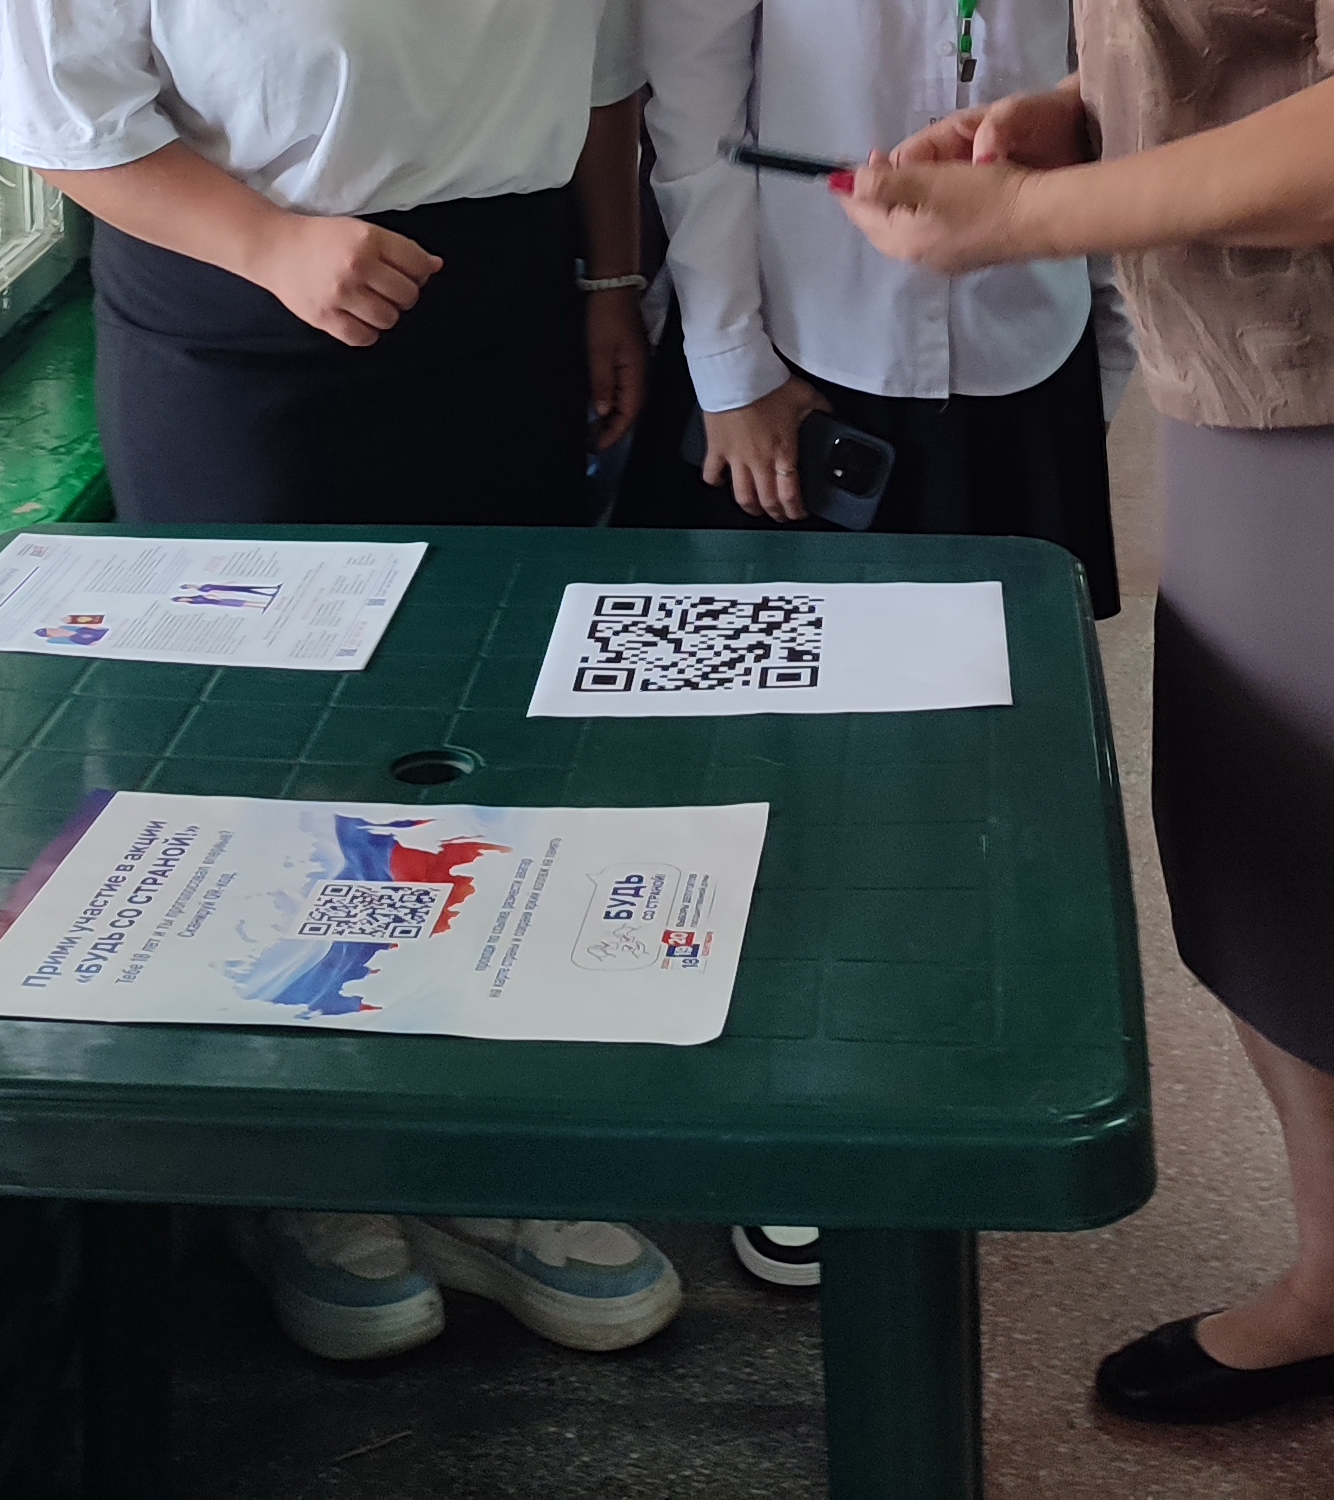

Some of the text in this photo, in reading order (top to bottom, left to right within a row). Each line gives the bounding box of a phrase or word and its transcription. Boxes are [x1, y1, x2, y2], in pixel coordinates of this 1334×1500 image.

[21, 936, 81, 987] Прими
[68, 875, 126, 932] участие
[123, 820, 166, 860] акции
[74, 825, 199, 982] «БУДЬ СО СТРАНОЙ!»
[176, 901, 216, 937] Сканируй
[603, 874, 646, 919] БУДЬ
[642, 910, 655, 920] СО
[114, 964, 143, 983] Тебе
[130, 953, 150, 961] 18
[141, 937, 160, 952] лет
[156, 918, 173, 929] ты
[165, 866, 210, 917] проголосовал
[668, 932, 689, 945] 20
